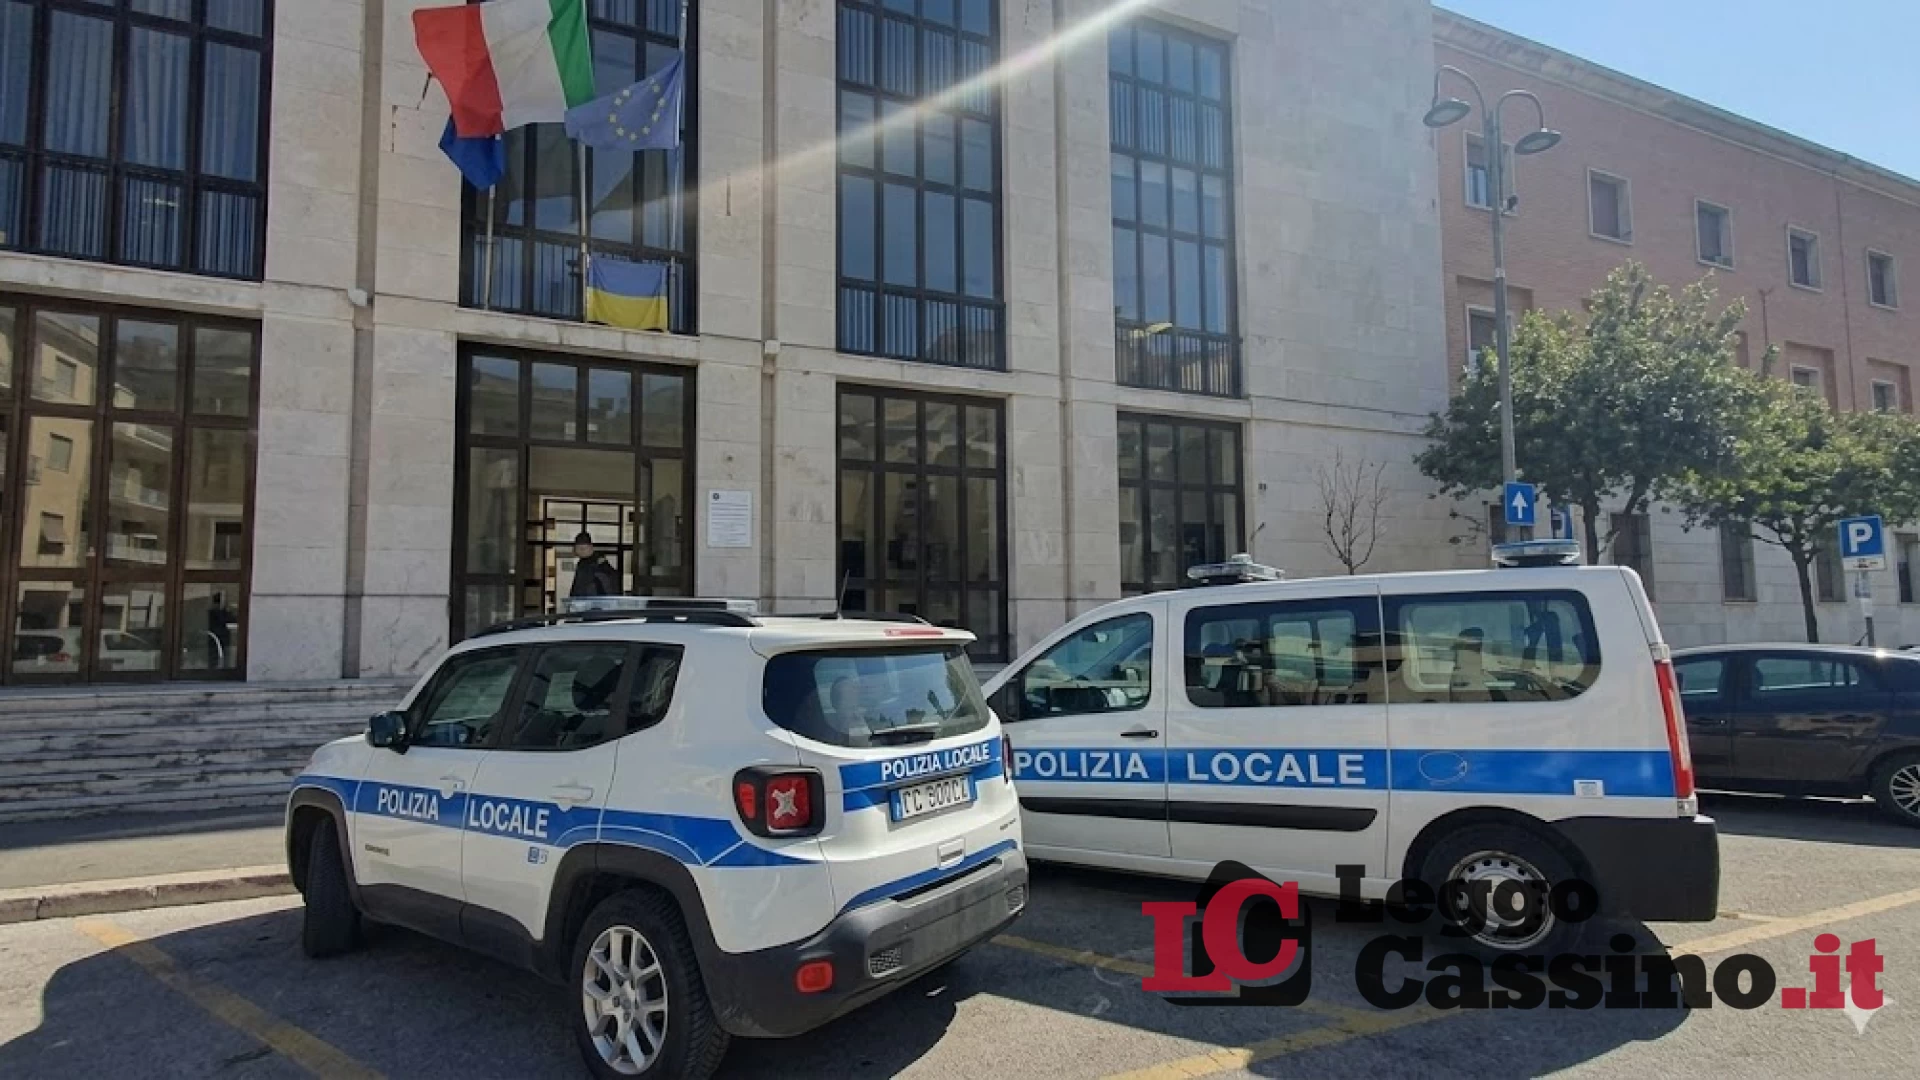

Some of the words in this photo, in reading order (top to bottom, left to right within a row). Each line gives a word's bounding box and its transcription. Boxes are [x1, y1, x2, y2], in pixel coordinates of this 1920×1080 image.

[1849, 522, 1873, 553] P
[881, 753, 942, 780] POLIZIA
[945, 743, 990, 769] LOCALE
[1013, 751, 1149, 779] POLIZIA
[1187, 752, 1366, 785] LOCALE
[378, 787, 439, 821] POLIZIA
[469, 799, 549, 838] LOCALE
